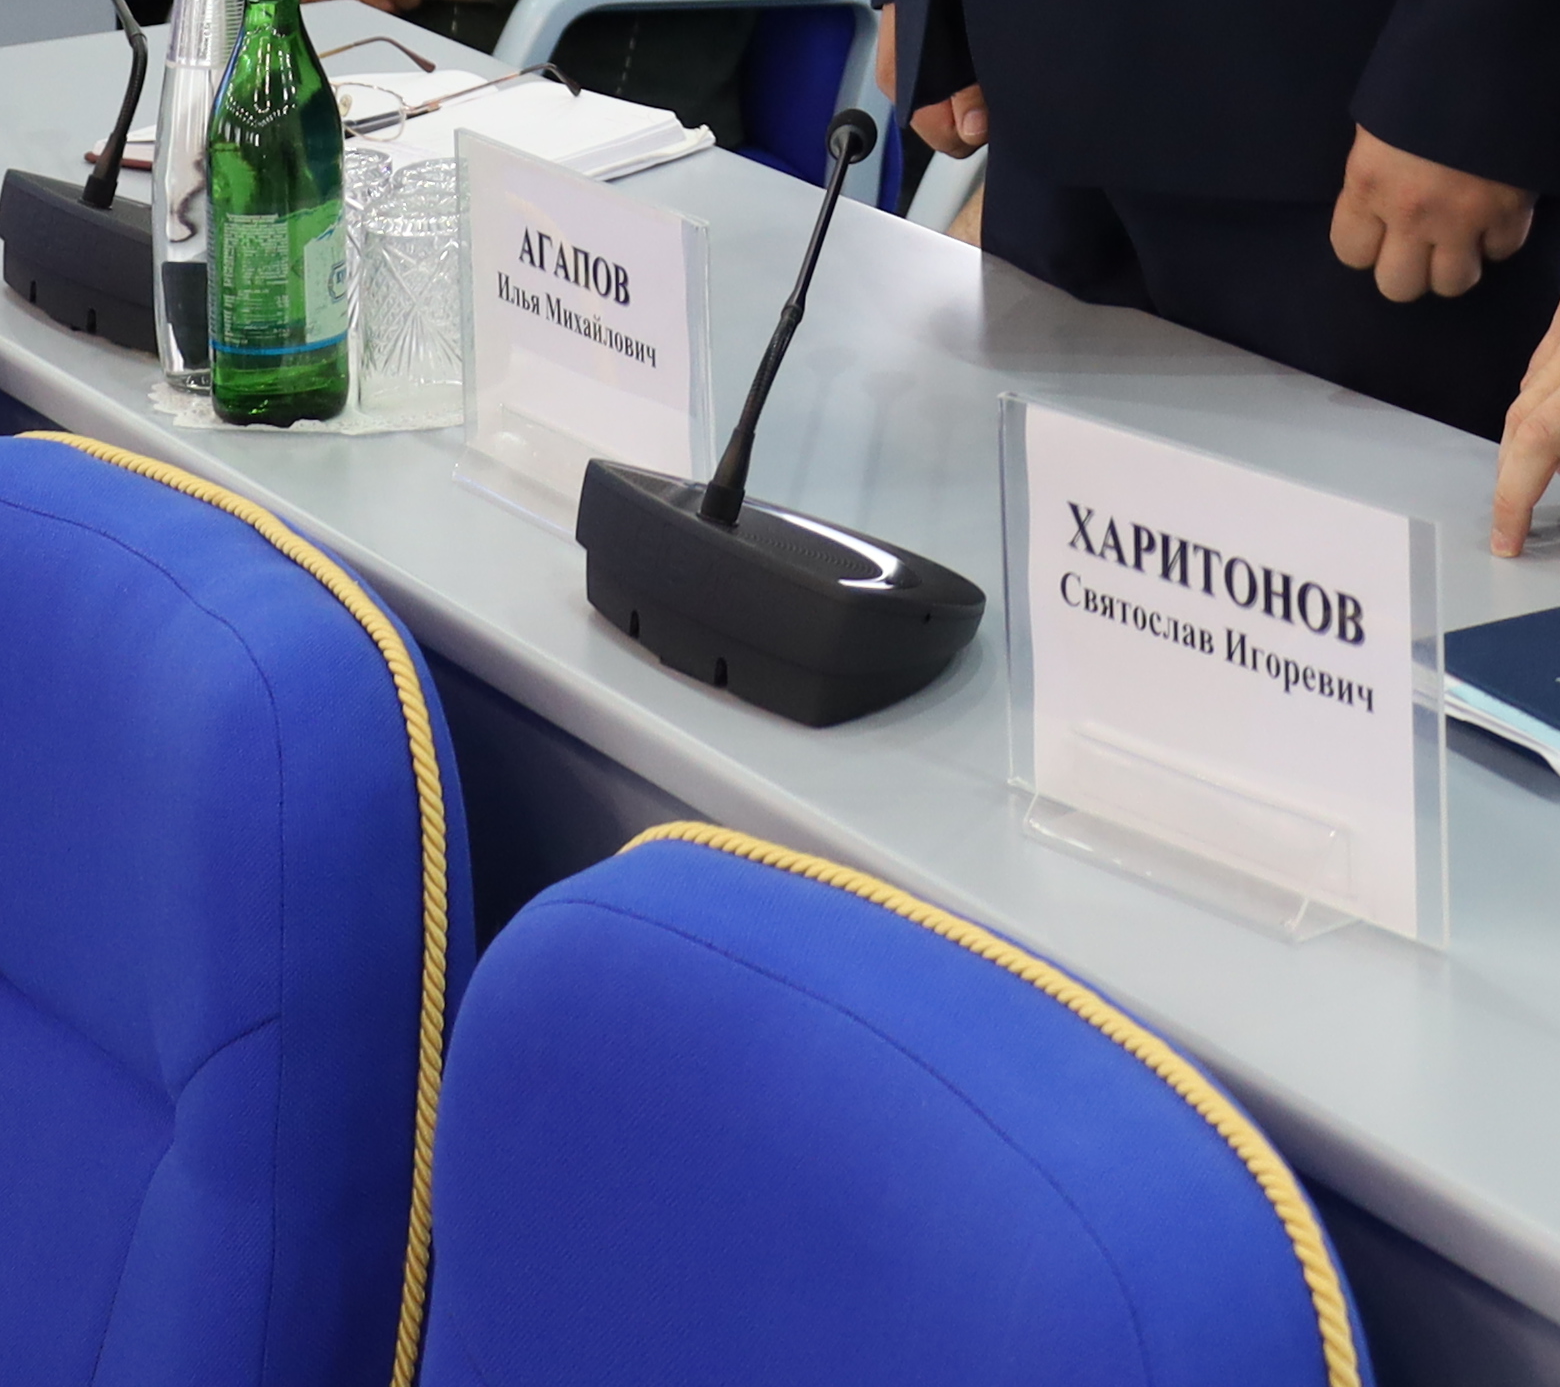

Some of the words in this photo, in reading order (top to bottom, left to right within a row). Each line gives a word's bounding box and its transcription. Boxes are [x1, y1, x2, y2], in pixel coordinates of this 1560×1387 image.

[497, 270, 541, 316] Илья
[545, 291, 657, 369] Михайлович
[518, 225, 630, 306] АГАПОВ
[1066, 500, 1366, 647] ХАРИТОНОВ
[1060, 571, 1215, 655] Святослав
[1224, 627, 1375, 713] Игоревич
